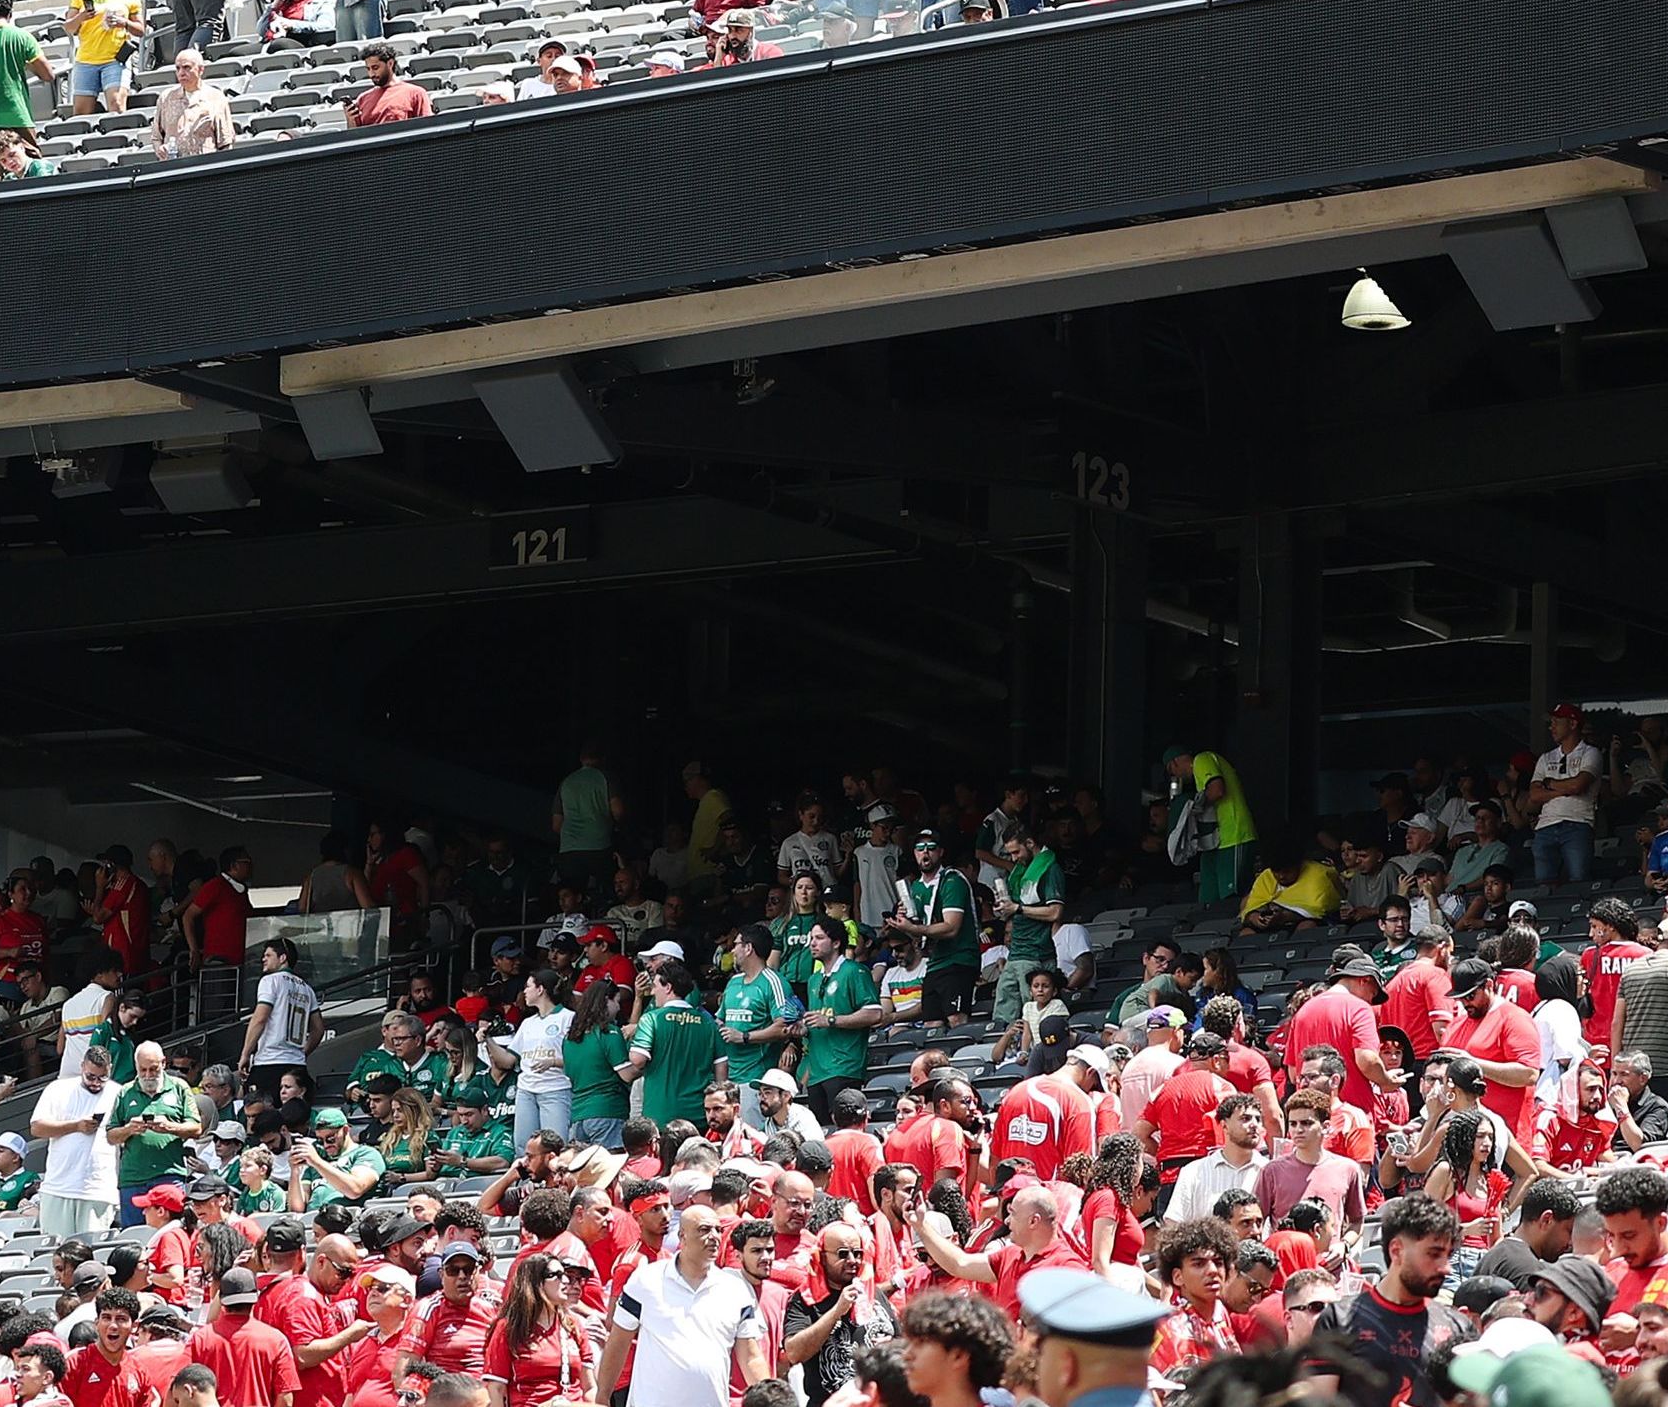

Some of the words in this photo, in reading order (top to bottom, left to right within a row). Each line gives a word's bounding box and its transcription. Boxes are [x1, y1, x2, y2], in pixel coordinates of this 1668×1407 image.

[1071, 450, 1131, 513] 123
[512, 527, 567, 566] 121
[788, 932, 811, 948] cref
[286, 1002, 310, 1048] 10
[665, 1011, 702, 1025] crefisa
